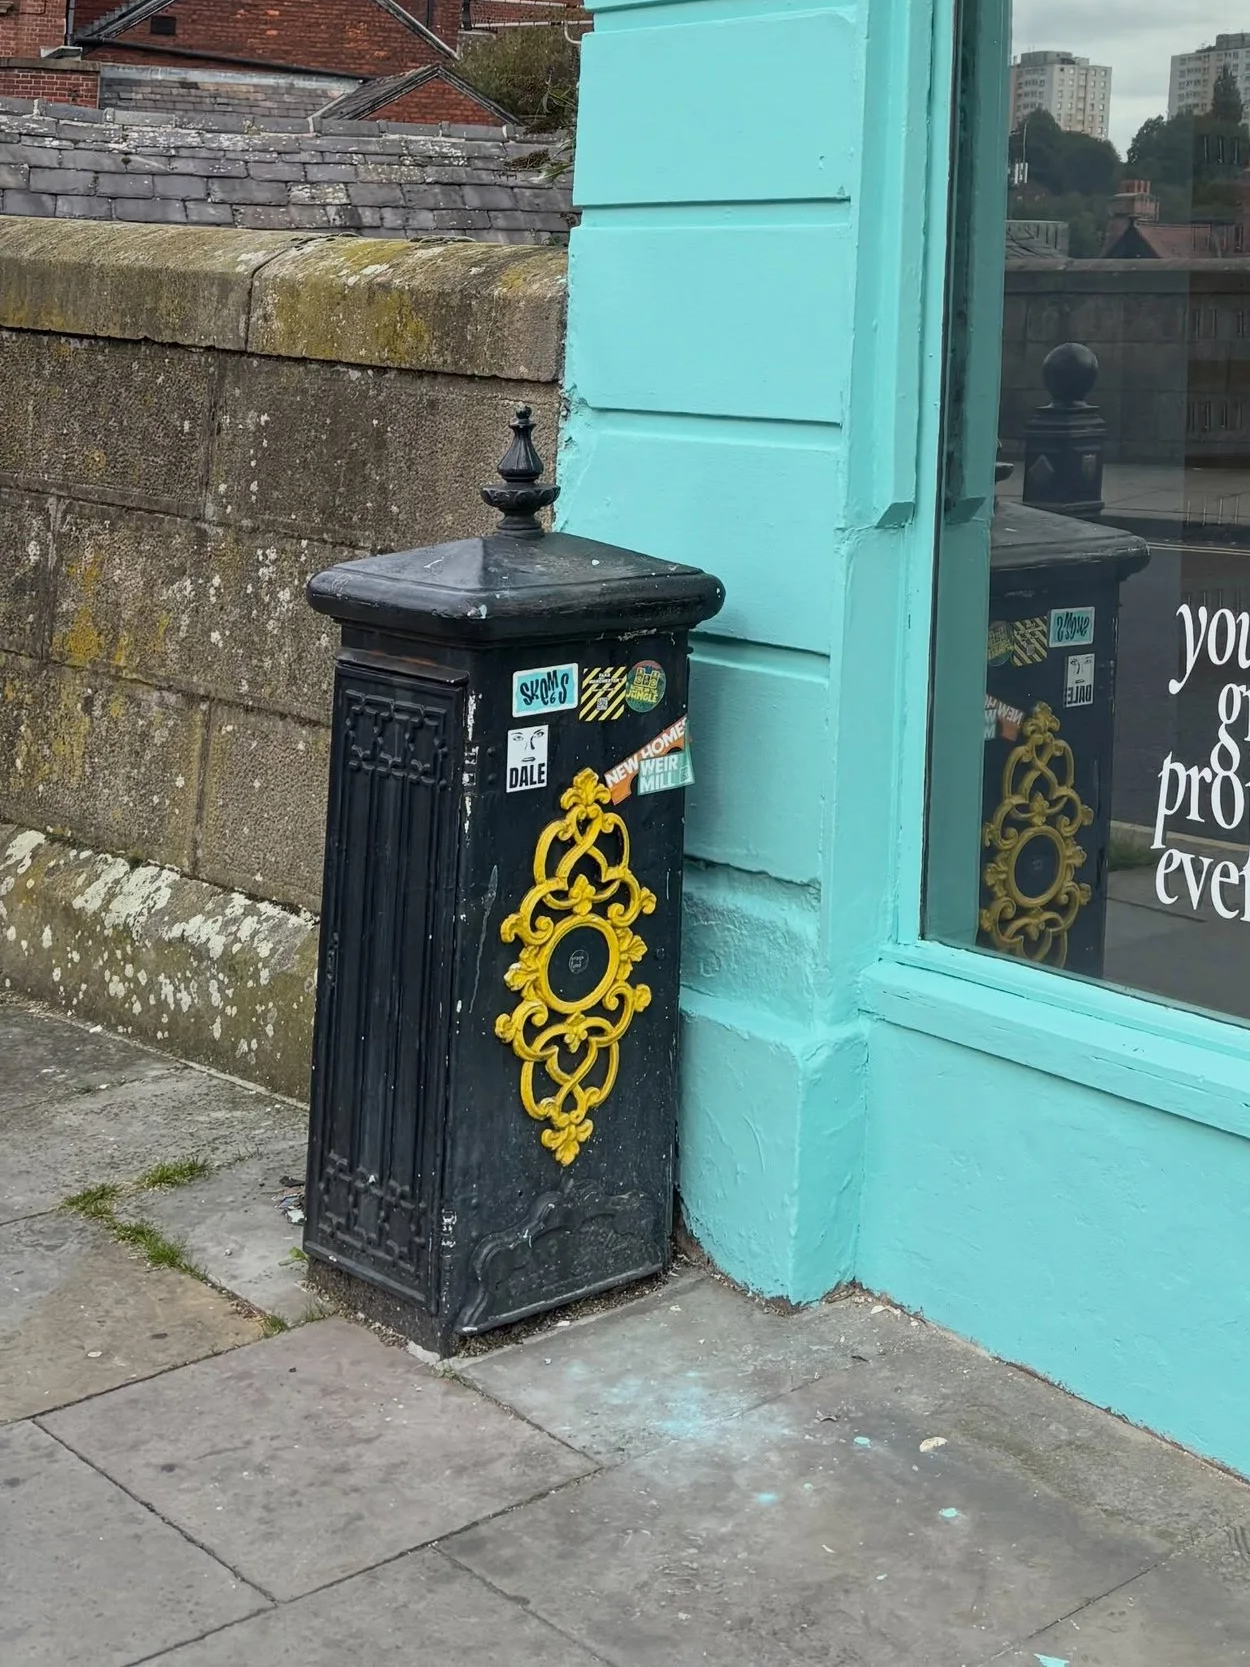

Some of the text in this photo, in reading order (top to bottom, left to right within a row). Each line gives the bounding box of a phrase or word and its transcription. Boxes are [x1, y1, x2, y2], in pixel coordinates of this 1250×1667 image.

[509, 762, 547, 790] DALE
[603, 754, 640, 789] NEW
[640, 754, 679, 776] WEIR
[639, 772, 674, 794] MILL
